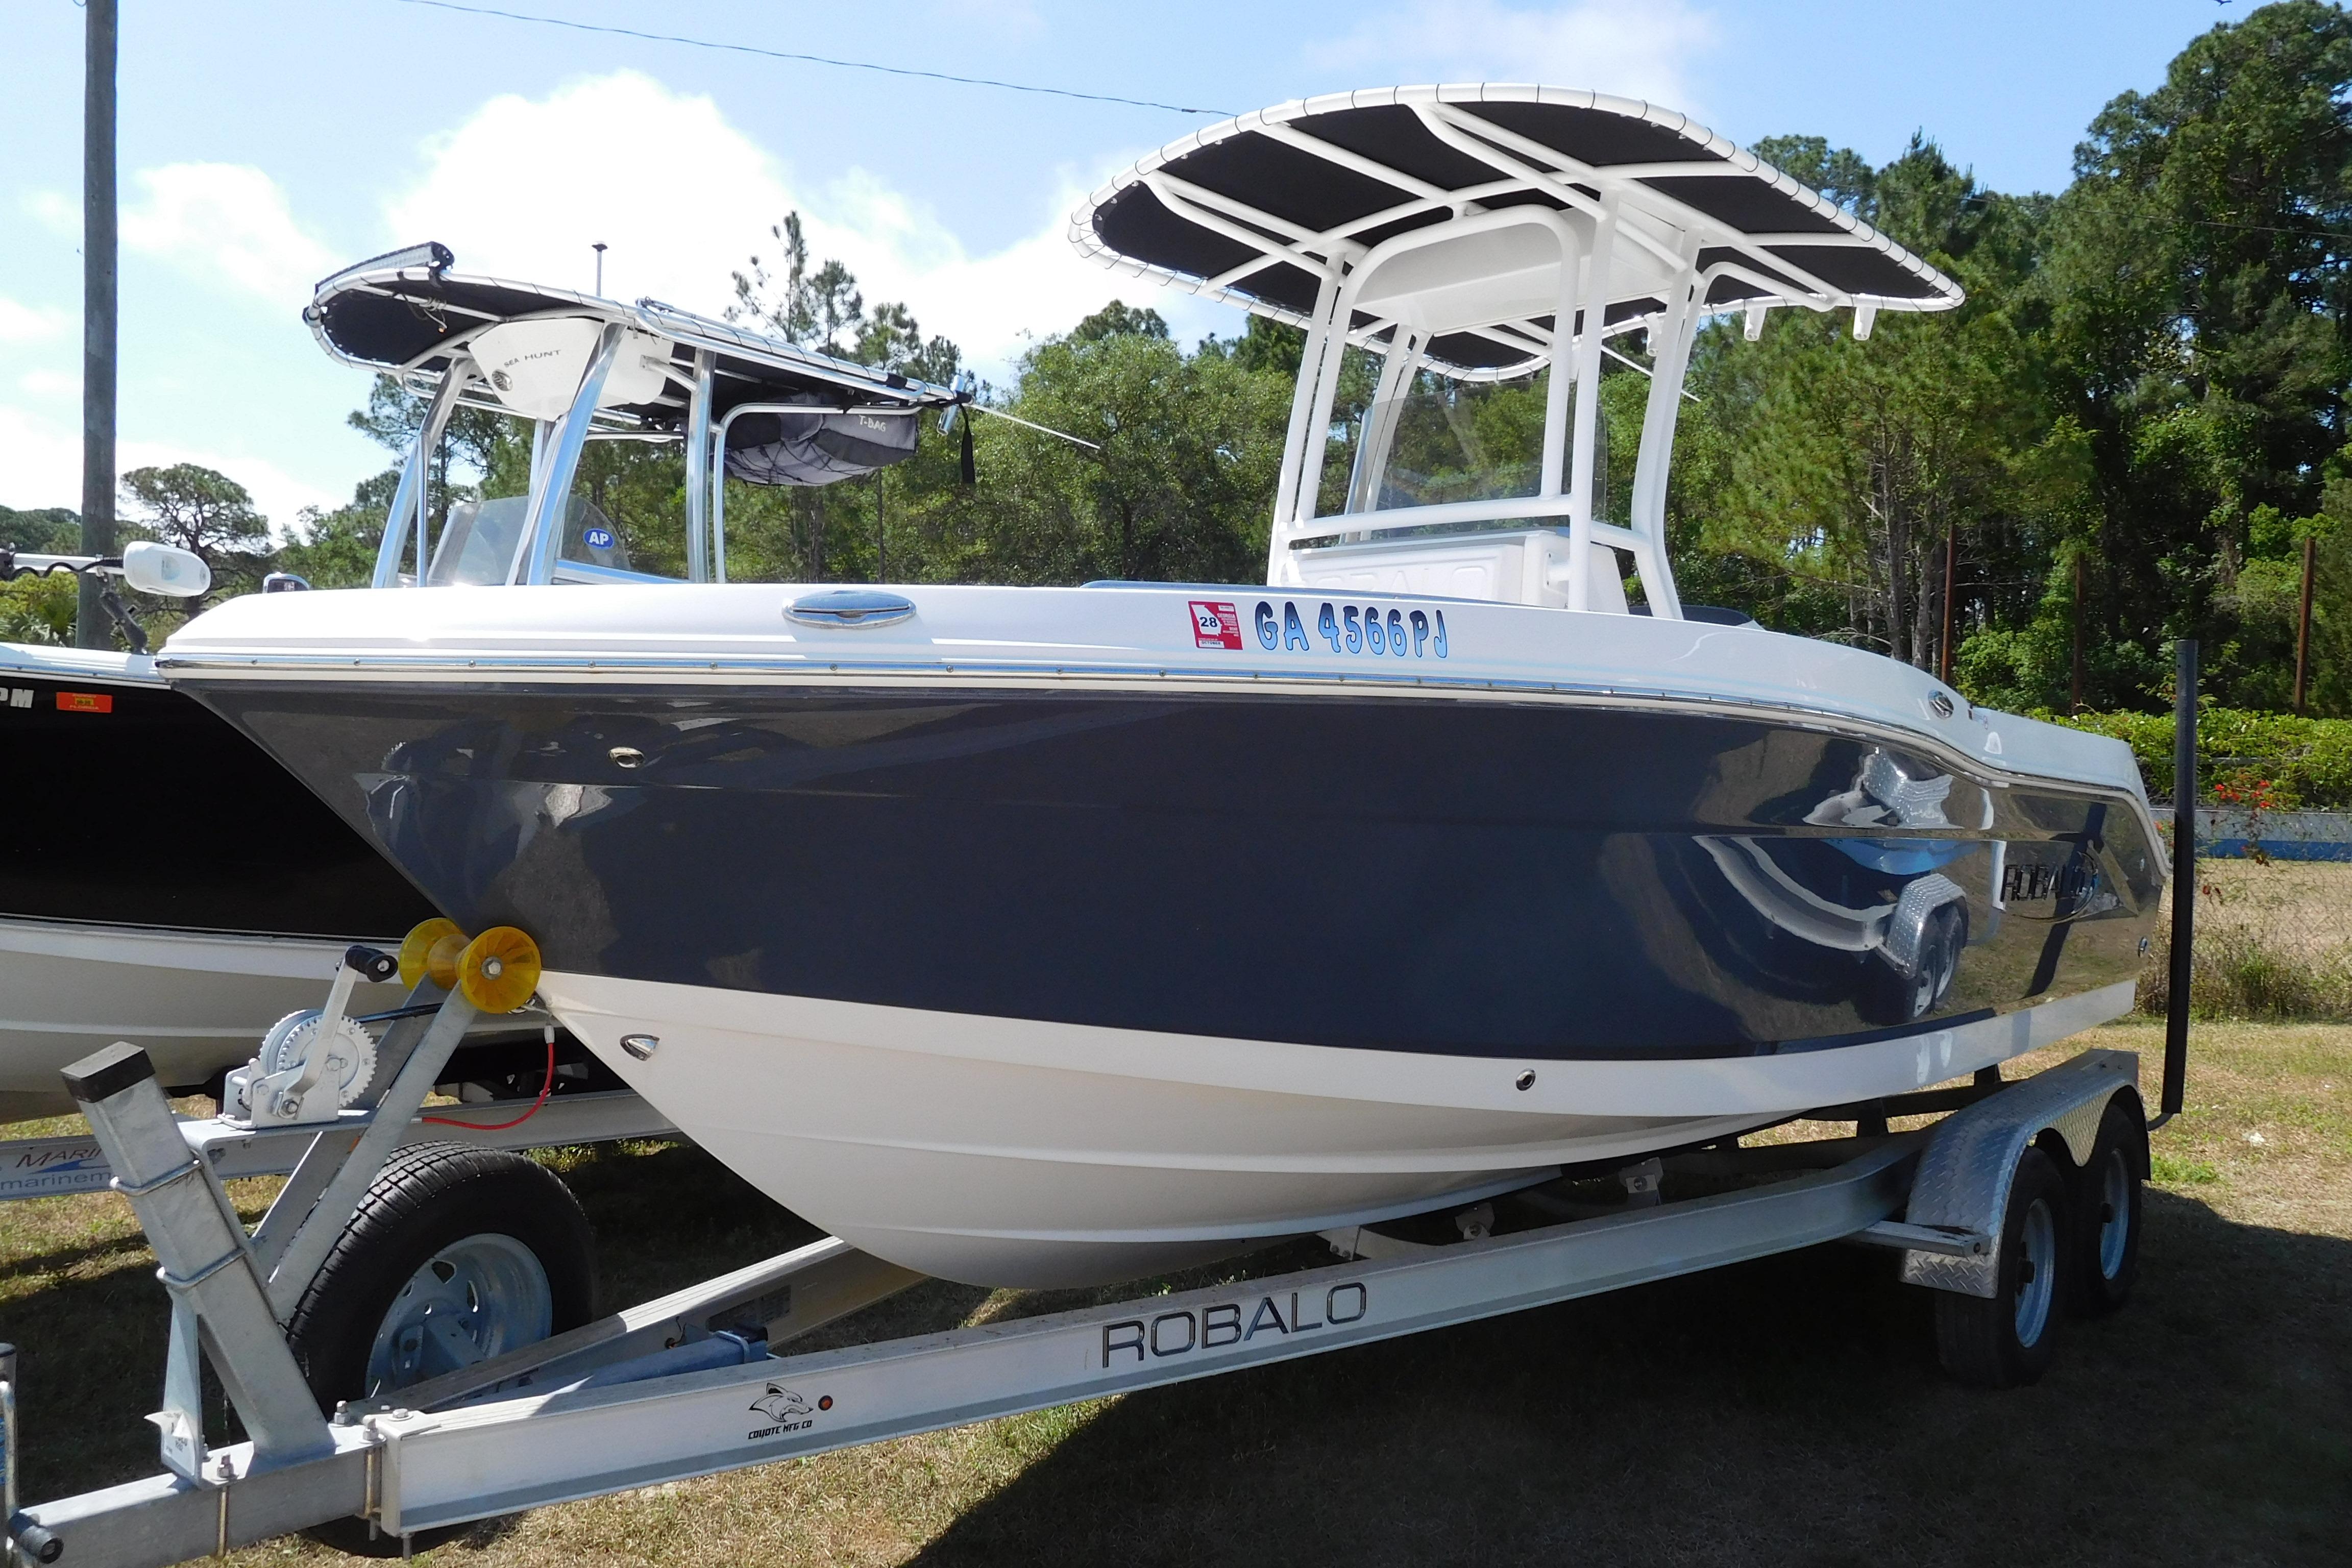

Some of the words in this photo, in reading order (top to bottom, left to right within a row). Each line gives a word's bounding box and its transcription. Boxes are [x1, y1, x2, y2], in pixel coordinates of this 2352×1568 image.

[504, 358, 520, 368] SEA
[525, 349, 561, 360] HUNT
[589, 531, 609, 545] AP
[1199, 617, 1218, 627] 28
[1255, 601, 1310, 651] GA
[1318, 602, 1448, 658] 4566PJ
[1102, 1282, 1367, 1368] ROBALO
[748, 1426, 782, 1439] COYOTE
[782, 1422, 800, 1433] MFG
[801, 1420, 813, 1429] CO
